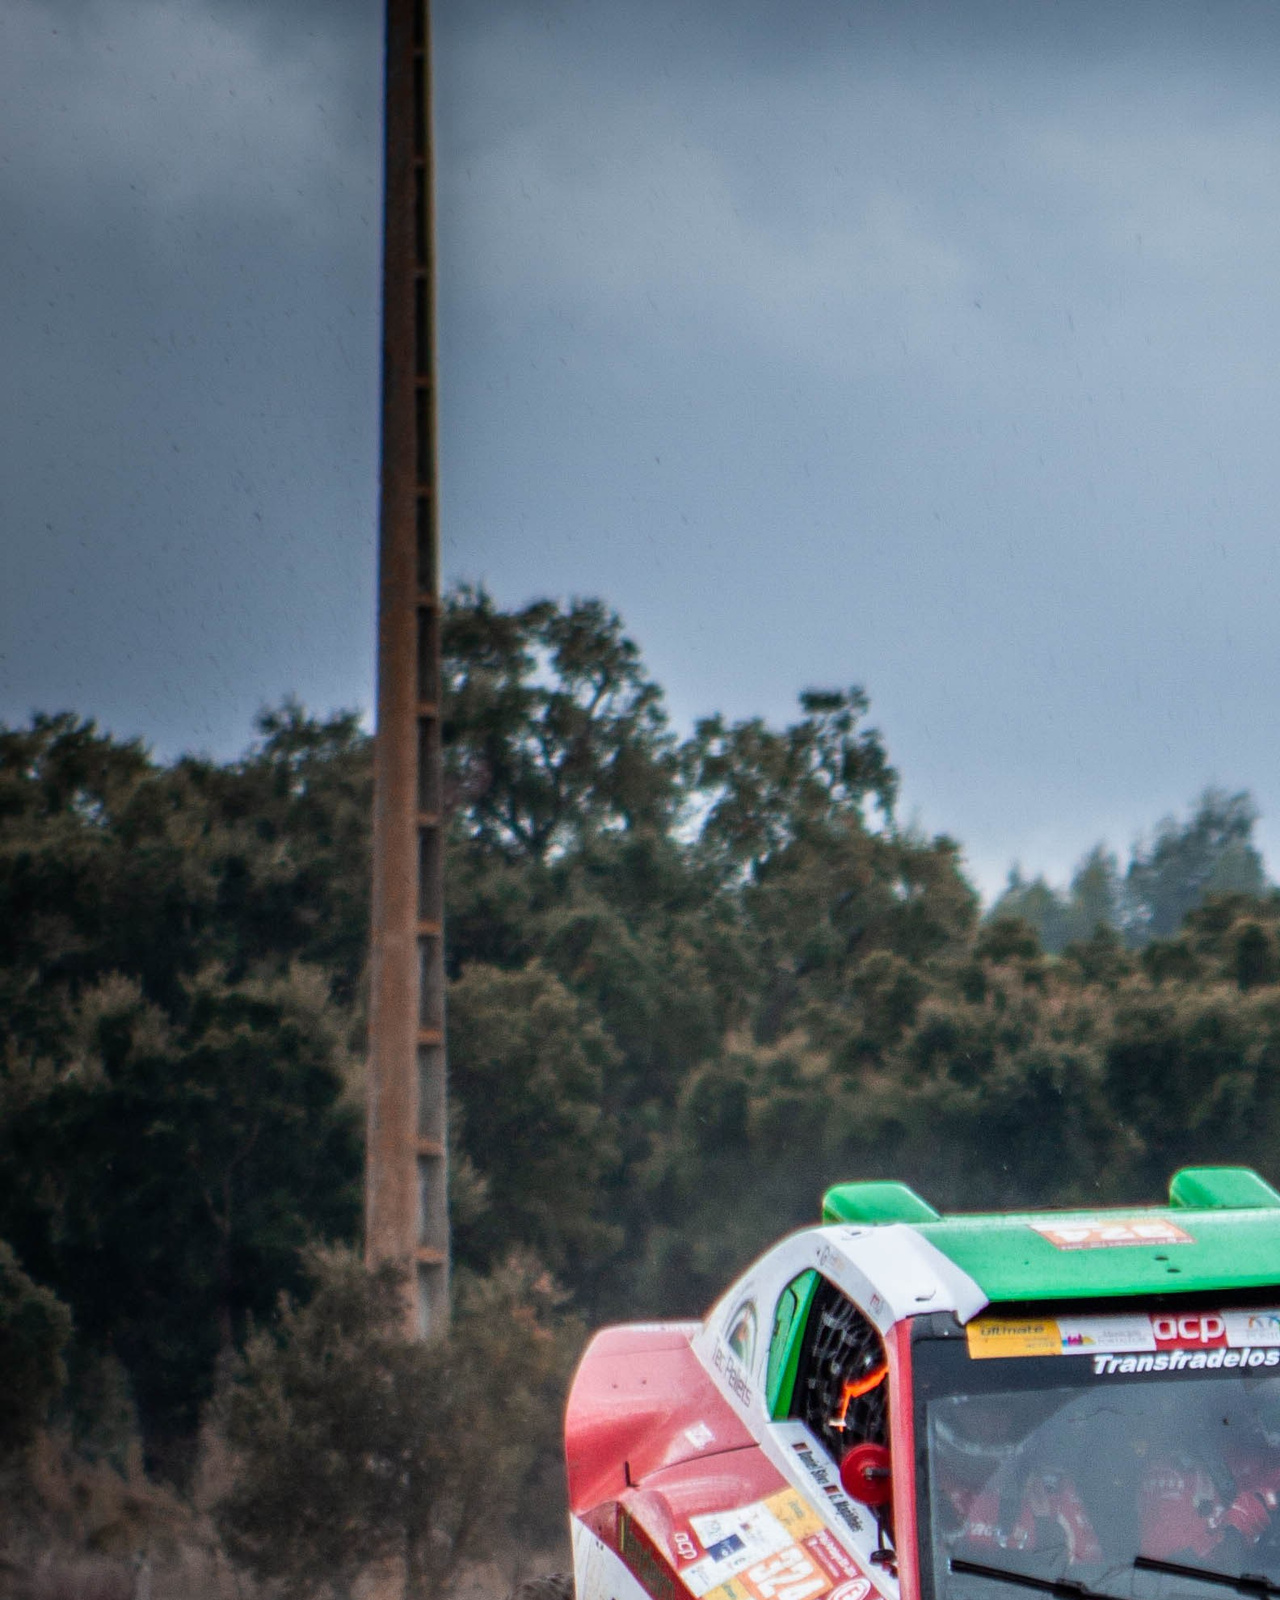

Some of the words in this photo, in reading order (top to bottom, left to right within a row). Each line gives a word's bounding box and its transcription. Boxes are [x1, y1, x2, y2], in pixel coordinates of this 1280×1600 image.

[1153, 1315, 1225, 1343] acp
[1093, 1347, 1280, 1376] Transfradelos
[674, 1532, 697, 1560] acp
